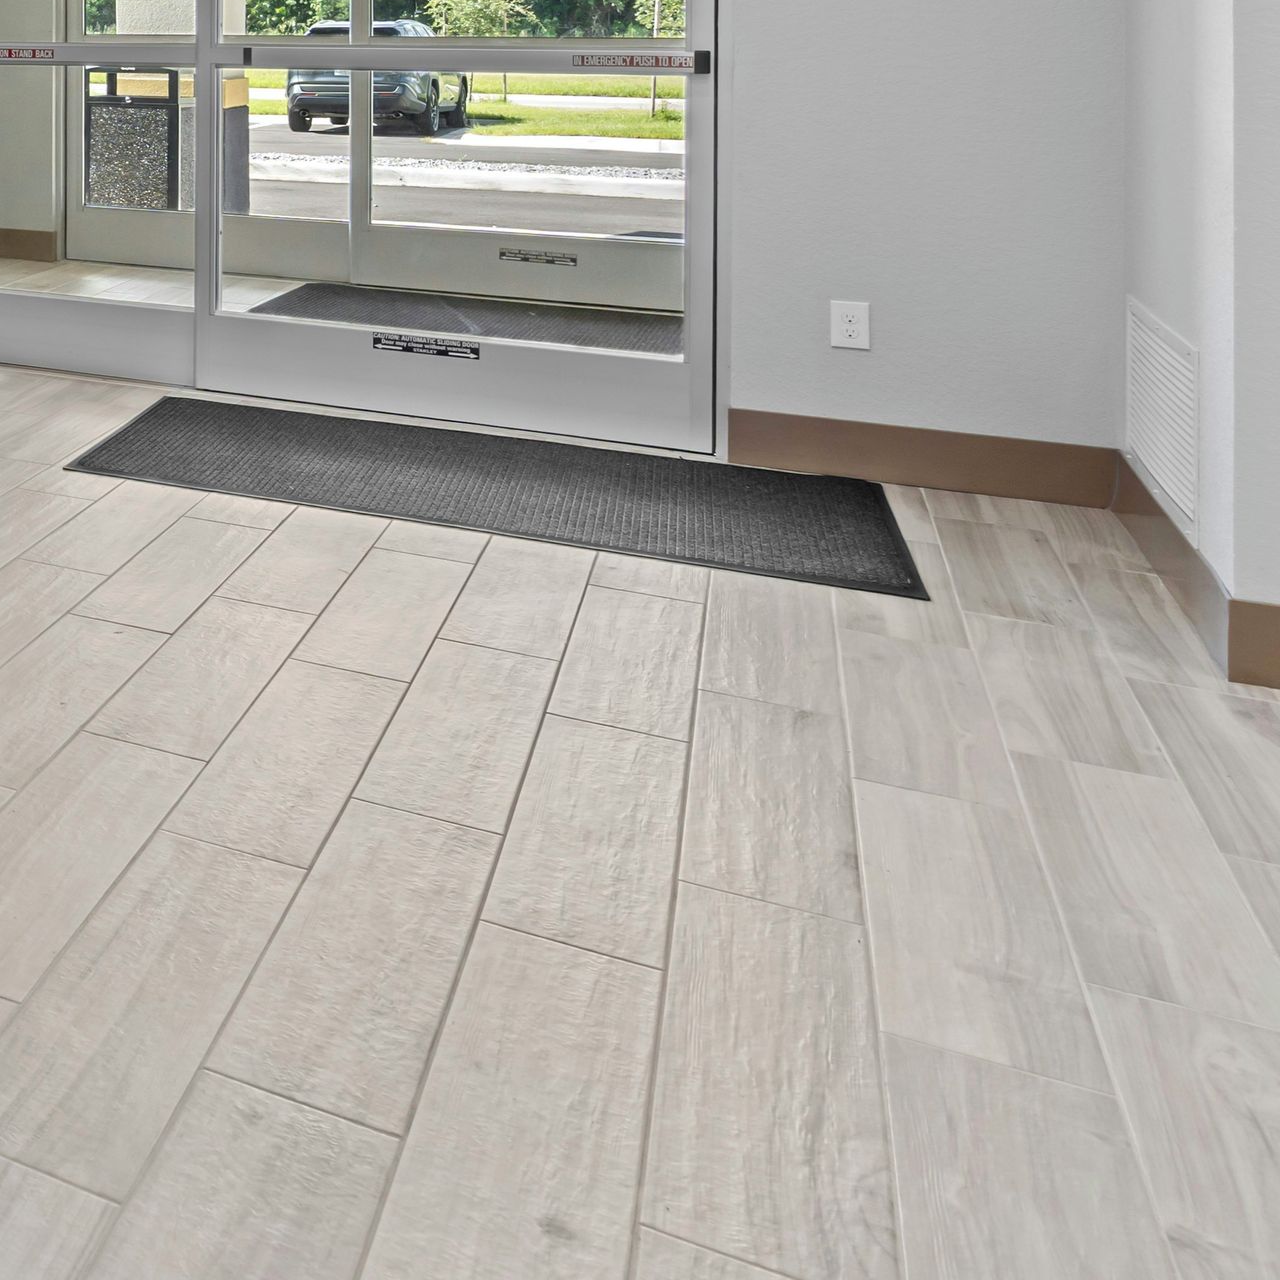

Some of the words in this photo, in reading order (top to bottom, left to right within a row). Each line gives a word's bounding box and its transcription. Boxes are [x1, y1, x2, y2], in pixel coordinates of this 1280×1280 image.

[11, 49, 33, 58] STAND
[35, 49, 53, 58] BACK
[573, 55, 581, 66] IN
[584, 55, 630, 66] EMERGENCY
[633, 56, 656, 67] PUSH
[658, 56, 669, 67] TO
[671, 56, 693, 67] OPEN
[401, 335, 436, 344] AUTOMATIC
[437, 339, 461, 347] SLIDING
